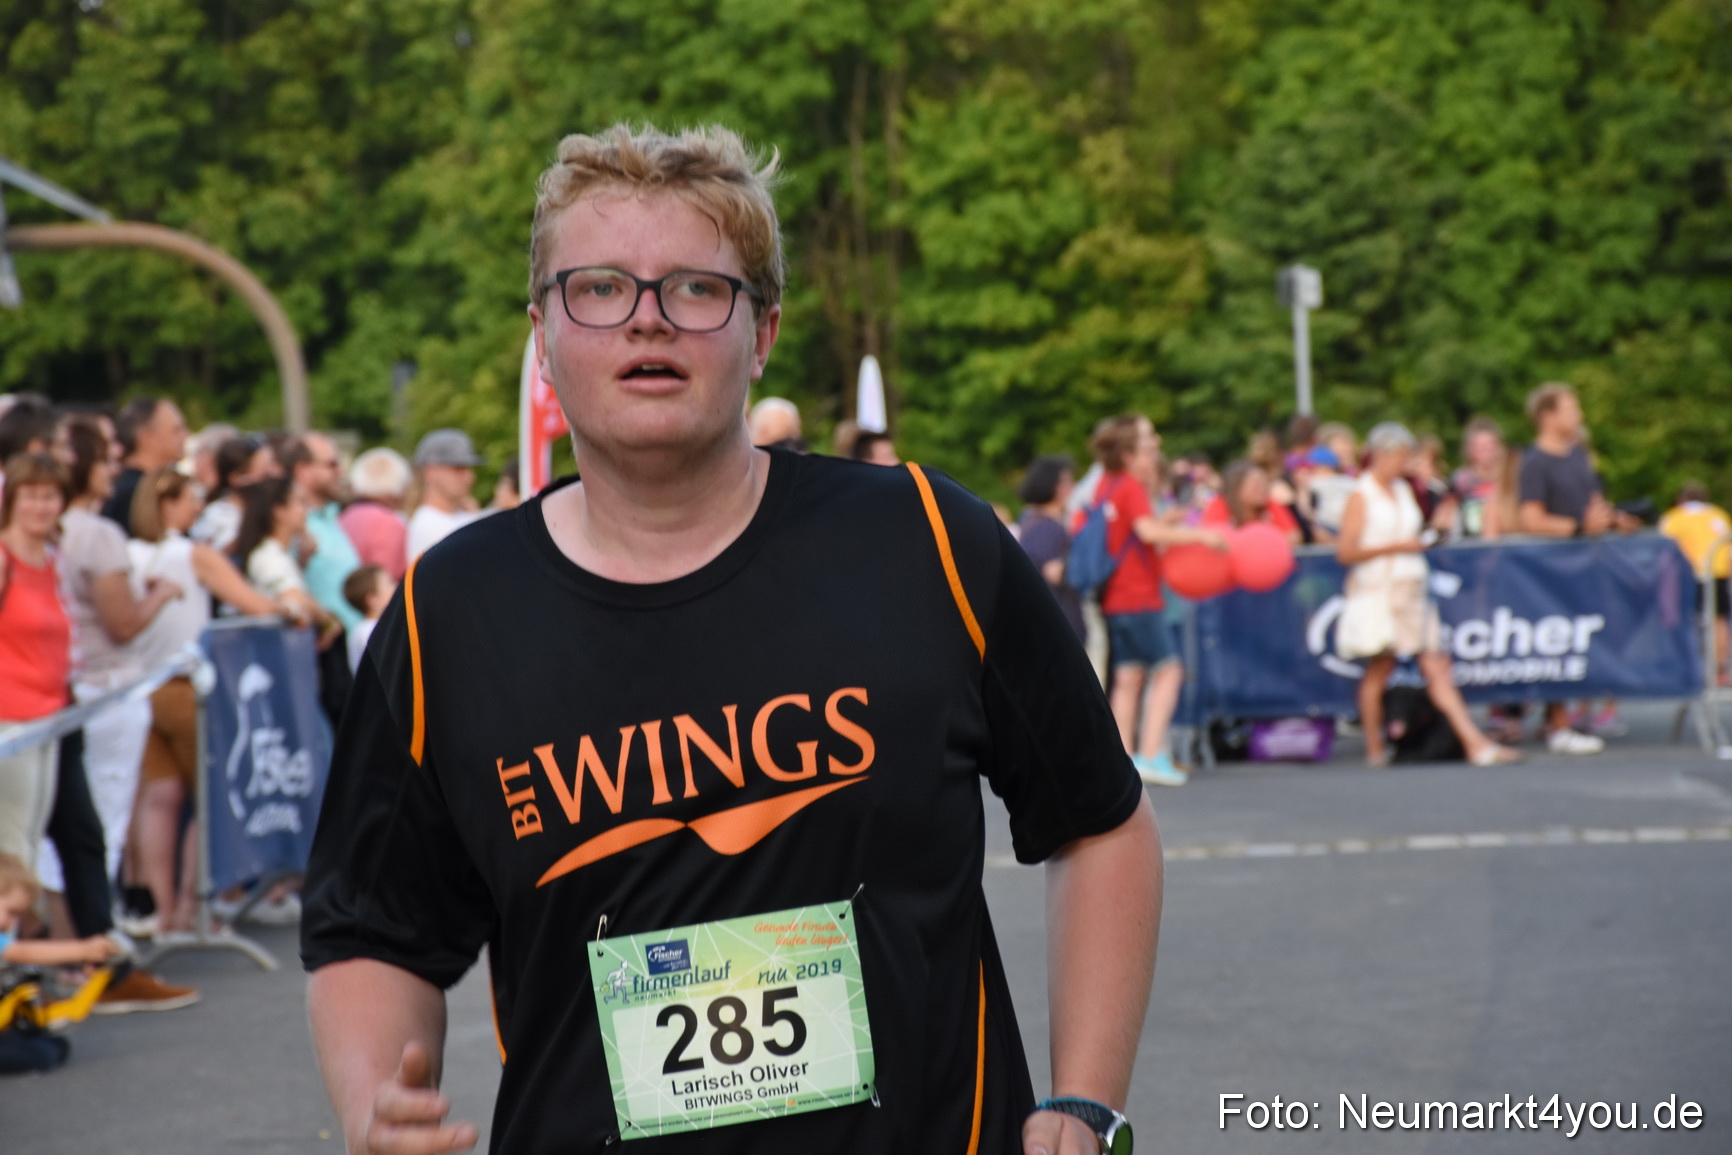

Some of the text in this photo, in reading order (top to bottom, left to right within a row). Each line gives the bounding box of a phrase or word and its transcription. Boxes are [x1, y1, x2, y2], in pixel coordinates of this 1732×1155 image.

[496, 688, 876, 840] BIT WINGS
[633, 959, 732, 994] firmenlauf
[796, 957, 842, 981] 2019
[656, 986, 807, 1075] 285
[671, 1062, 809, 1096] Larisch Oliver
[684, 1088, 753, 1110] BITWINGS
[757, 1082, 799, 1099] GmbH
